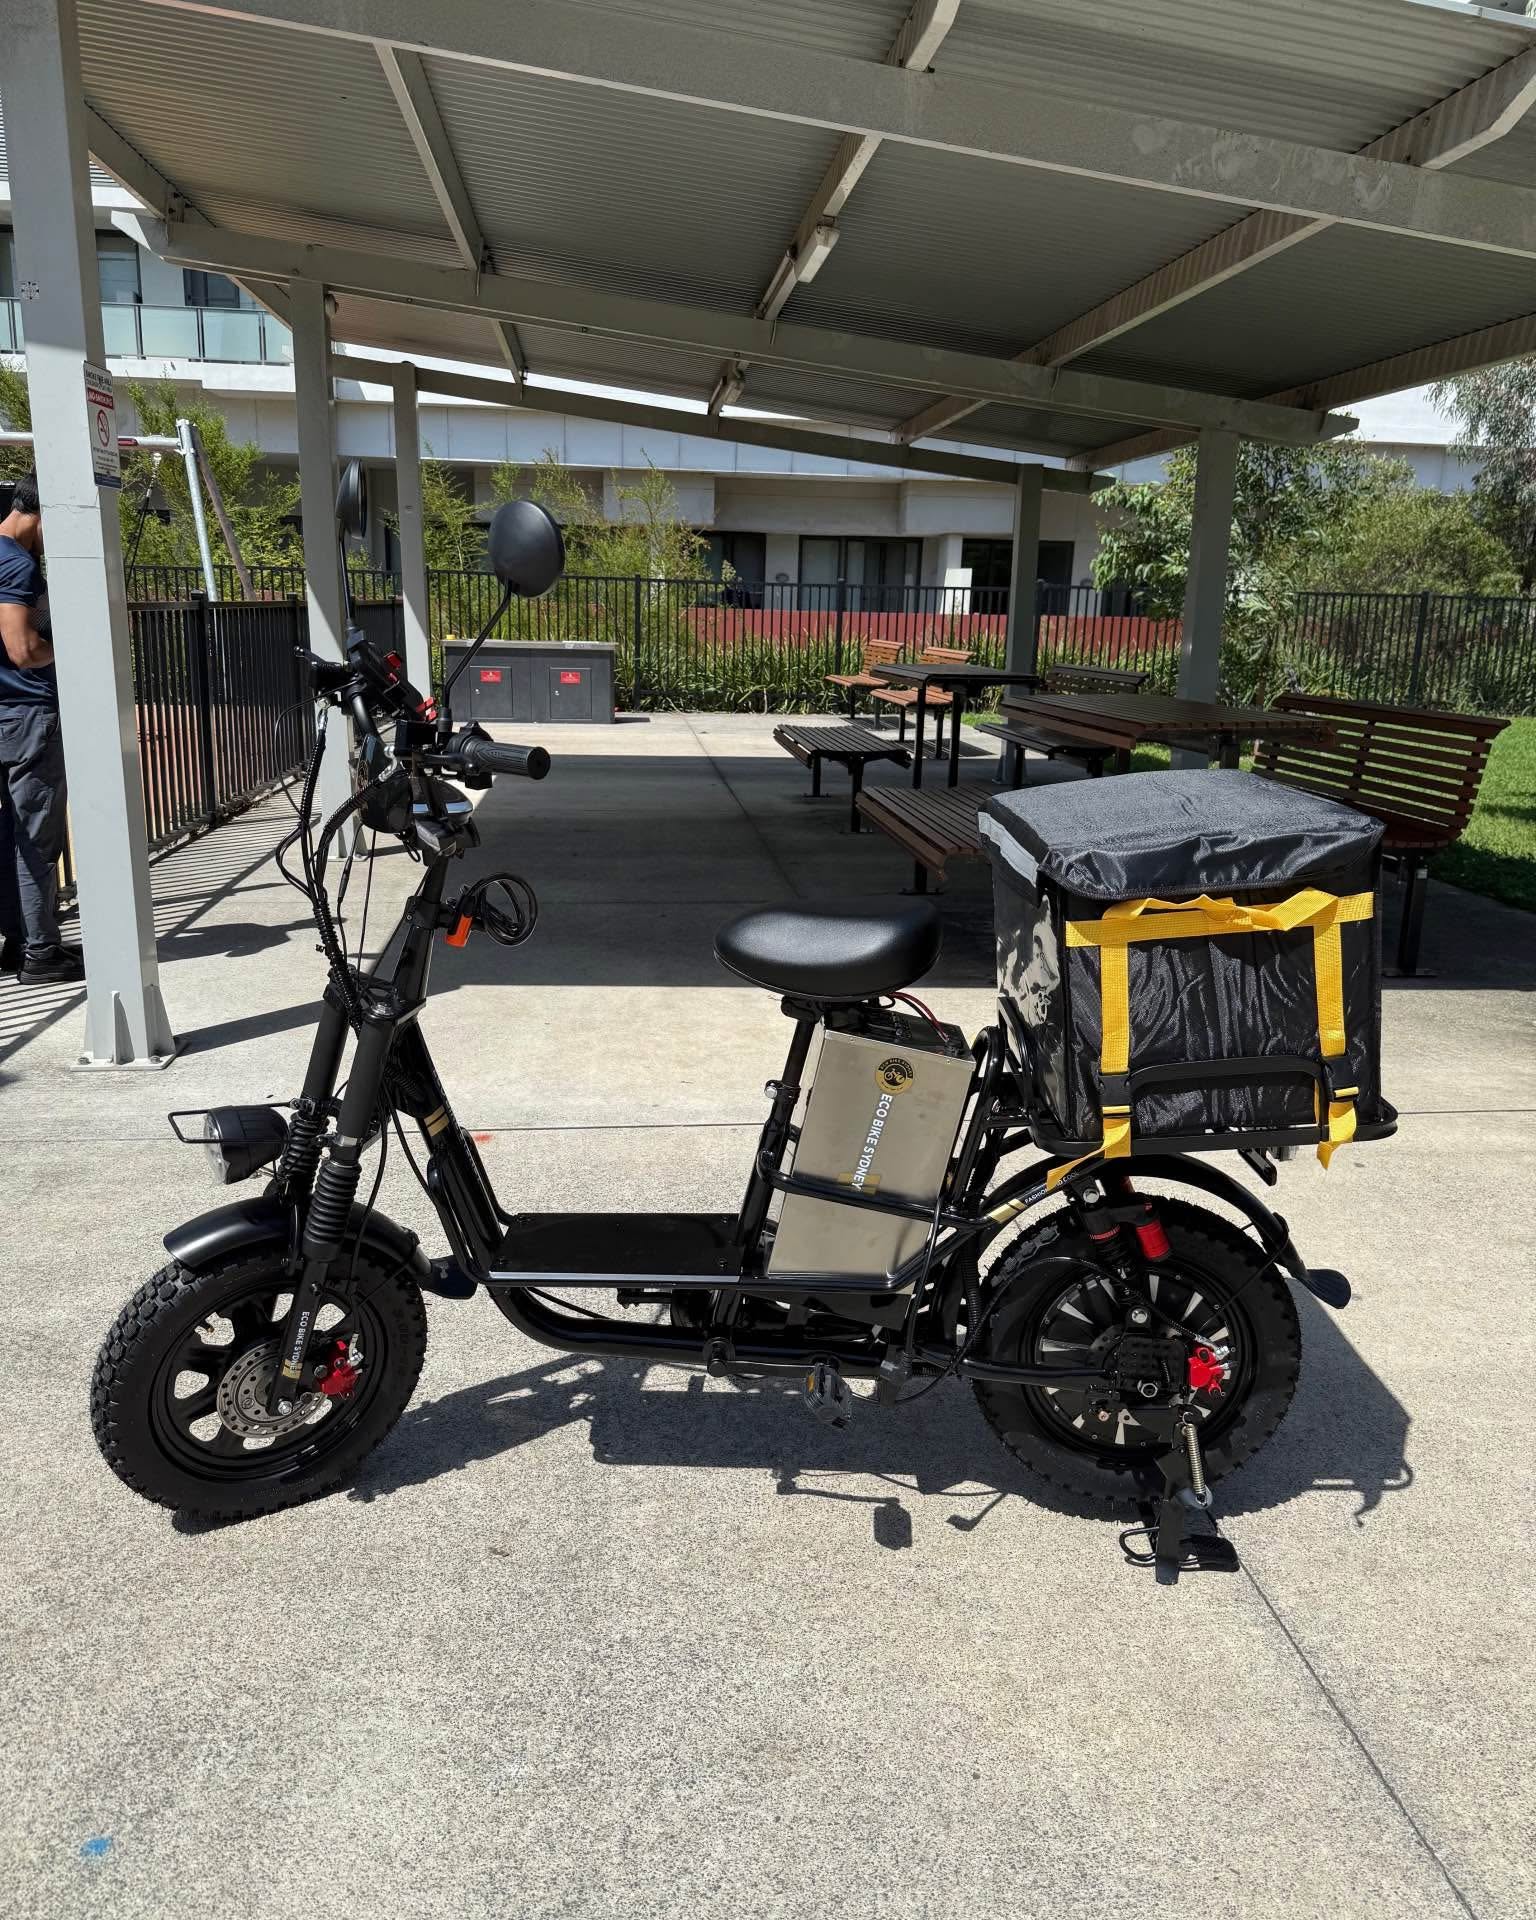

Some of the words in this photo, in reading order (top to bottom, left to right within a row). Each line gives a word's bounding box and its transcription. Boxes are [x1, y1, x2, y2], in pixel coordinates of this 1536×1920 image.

[876, 1093, 893, 1118] ECO
[866, 1118, 885, 1146] BIKE
[851, 1145, 875, 1191] SYDNEY
[1024, 1189, 1048, 1203] FASHIO
[300, 1311, 310, 1327] ECO
[295, 1328, 306, 1345] BIKE
